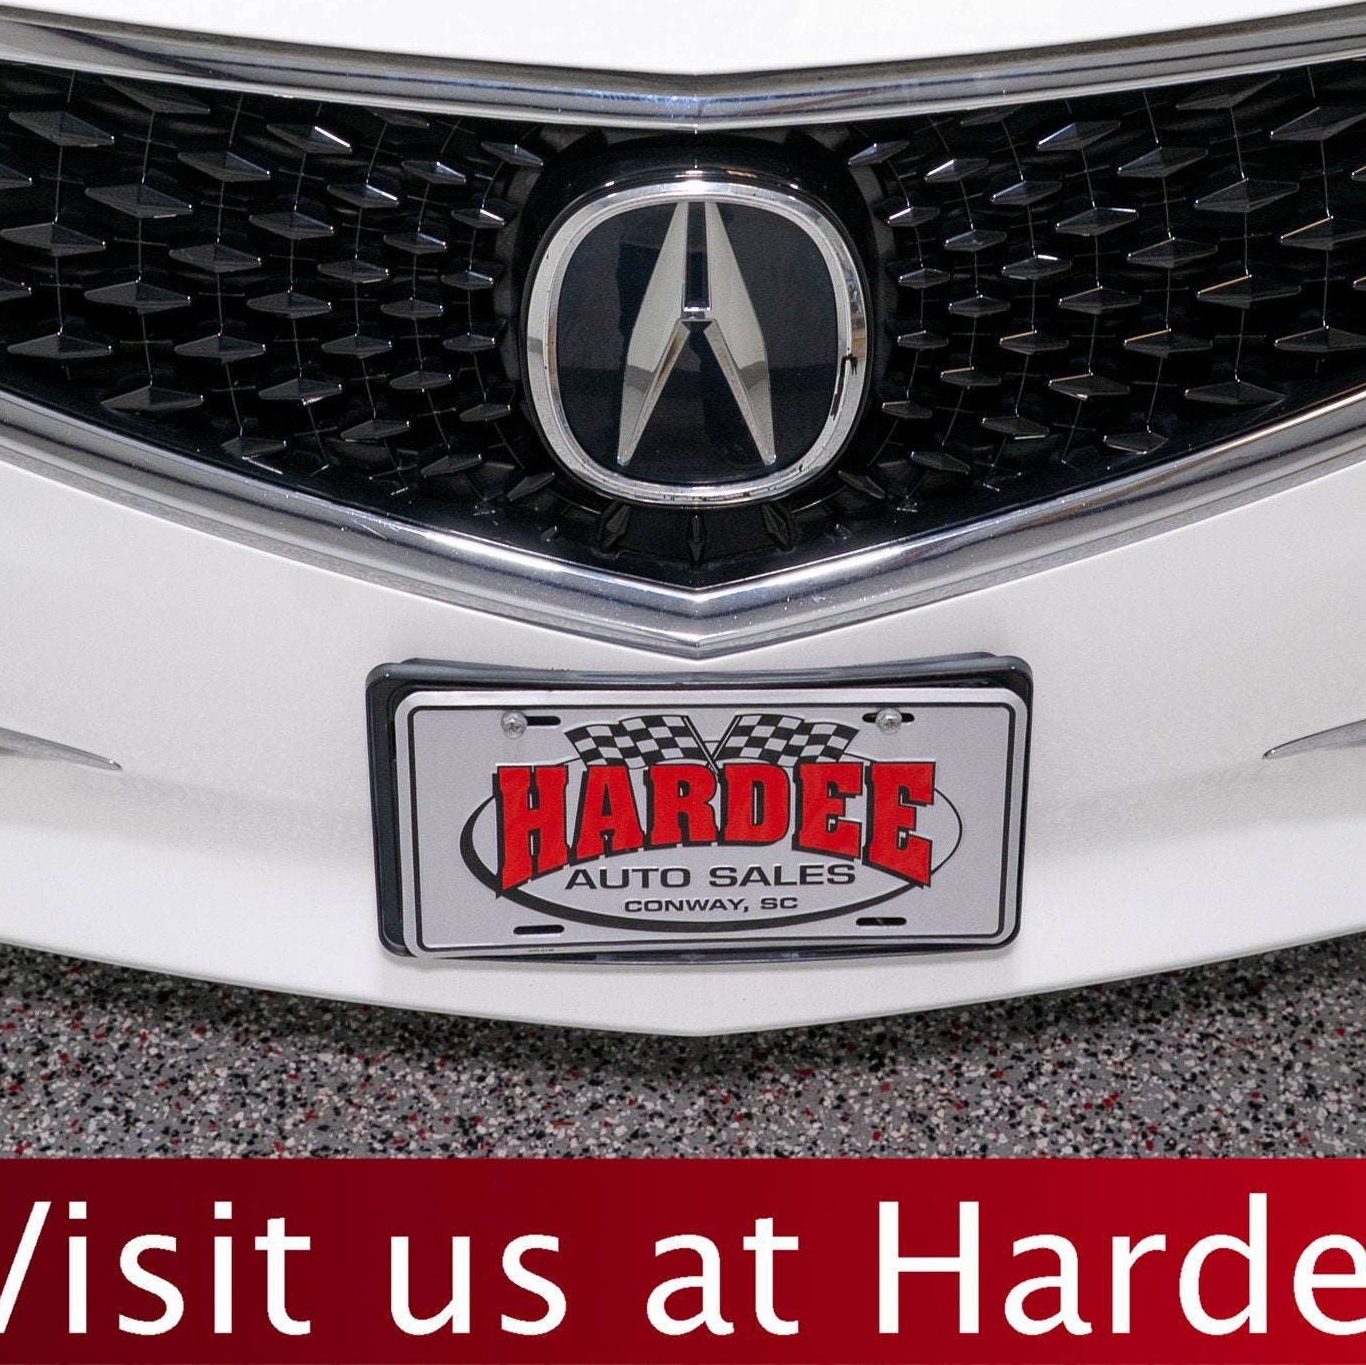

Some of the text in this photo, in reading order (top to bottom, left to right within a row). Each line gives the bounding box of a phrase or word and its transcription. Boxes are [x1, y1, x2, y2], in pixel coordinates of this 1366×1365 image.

[492, 762, 936, 898] HARDEE
[564, 864, 856, 890] AUTO SALES
[624, 897, 799, 913] CONWAY, SC
